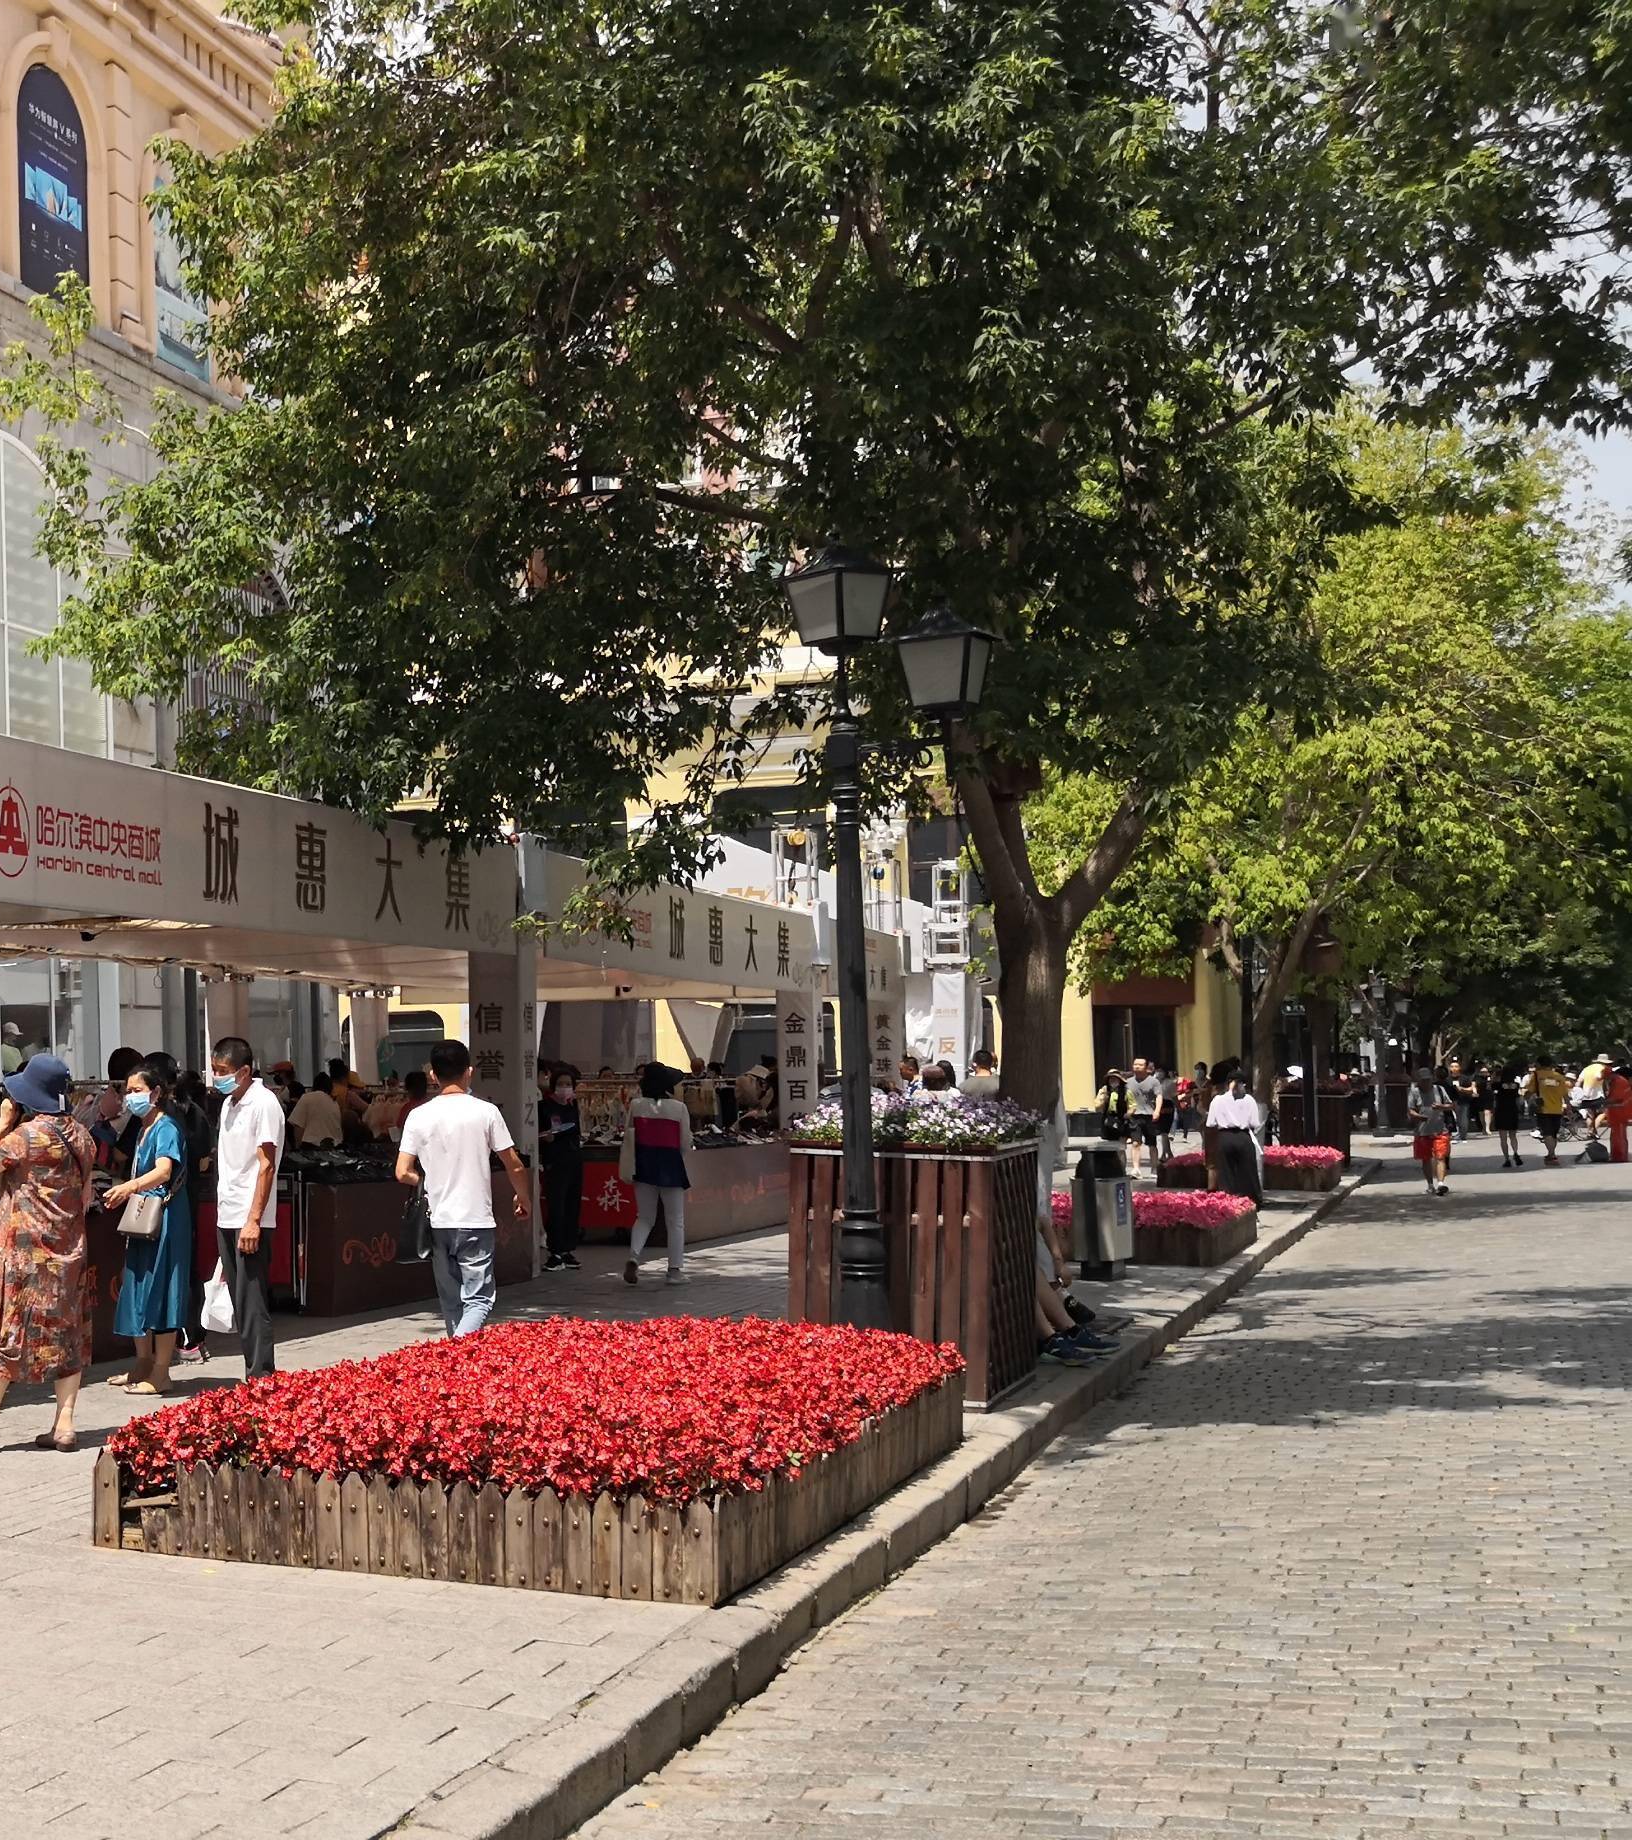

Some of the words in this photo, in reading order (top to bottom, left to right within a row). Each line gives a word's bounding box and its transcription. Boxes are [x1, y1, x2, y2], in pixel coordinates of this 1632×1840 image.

[36, 805, 161, 864] 哈尔滨中央商城
[36, 854, 84, 875] Harbin
[86, 862, 136, 883] central
[138, 871, 163, 886] mall
[203, 802, 470, 932] 城惠大集
[669, 895, 790, 978] 城惠大集
[474, 1002, 504, 1108] 信誉
